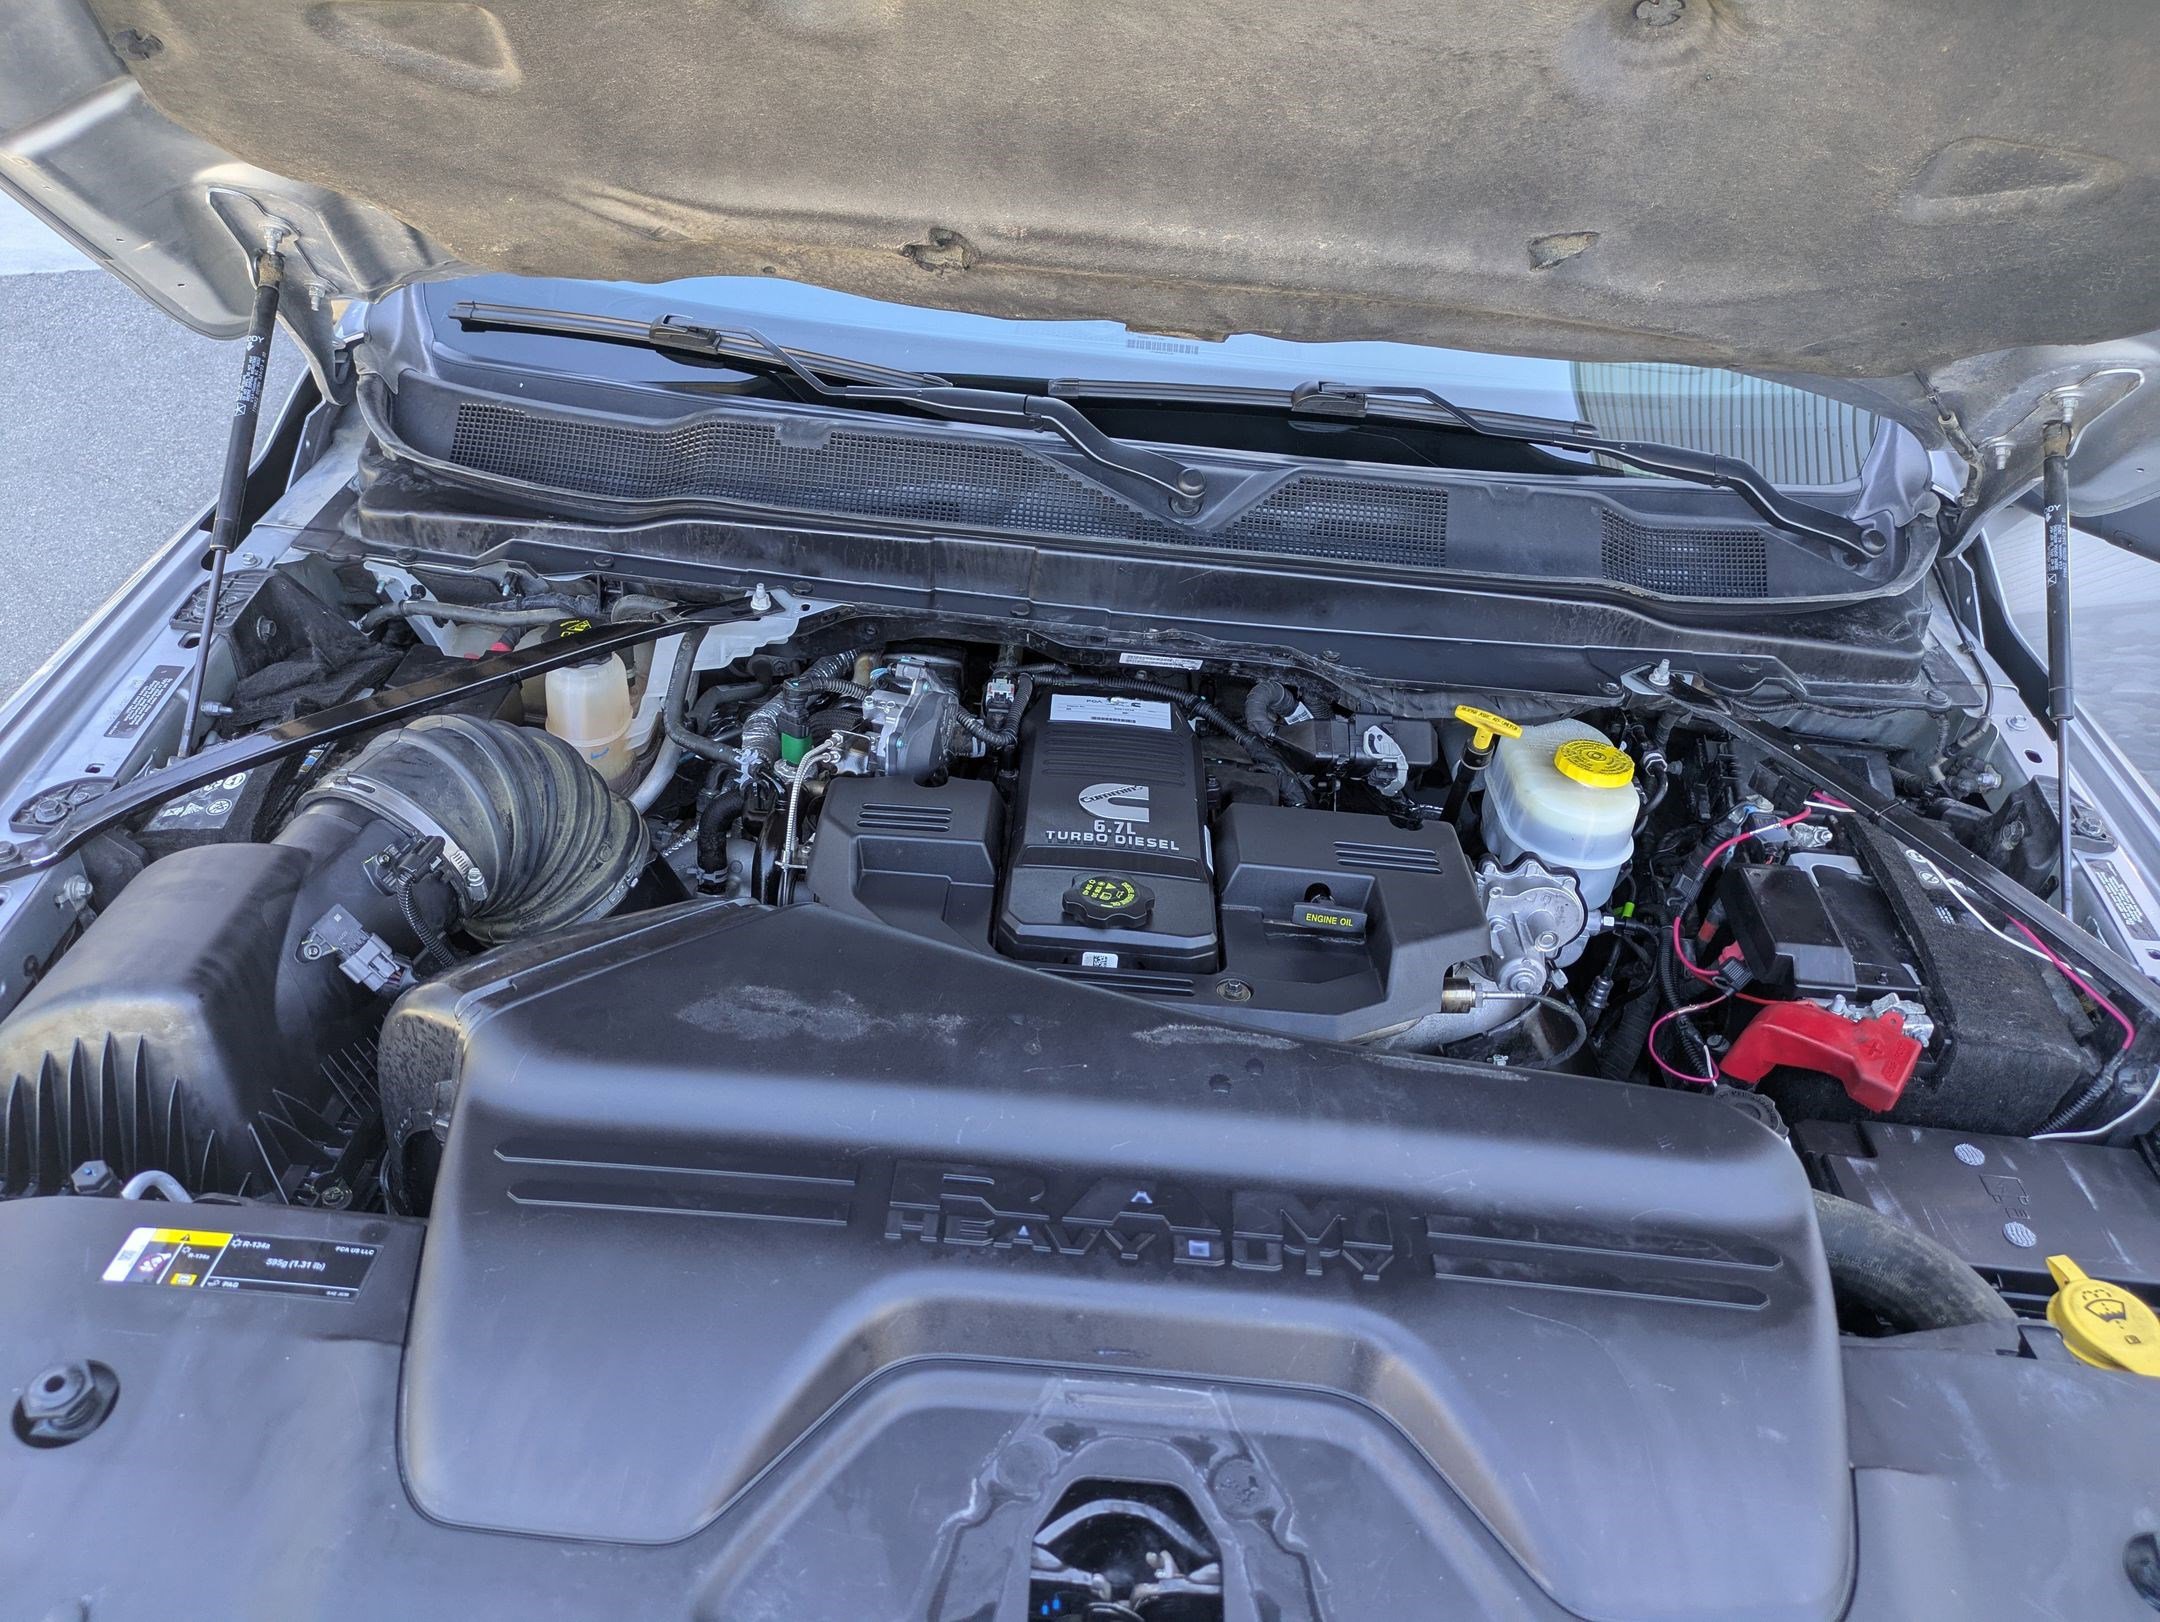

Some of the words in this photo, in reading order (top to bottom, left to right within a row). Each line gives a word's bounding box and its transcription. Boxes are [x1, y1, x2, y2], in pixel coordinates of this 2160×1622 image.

[1079, 785, 1144, 804] Cummins
[1093, 819, 1137, 835] 6.7L
[1046, 830, 1108, 844] TURBO
[1114, 834, 1181, 852] DIESEL
[1305, 913, 1338, 925] ENGINE
[1339, 917, 1353, 927] OIL
[889, 1160, 1393, 1251] RAM
[242, 1239, 271, 1250] R-134a
[885, 1209, 1156, 1261] HEAVY
[1173, 1228, 1395, 1281] DUTY
[265, 1257, 288, 1269] 595g
[288, 1259, 312, 1270] (1.31
[312, 1260, 327, 1272] lb)
